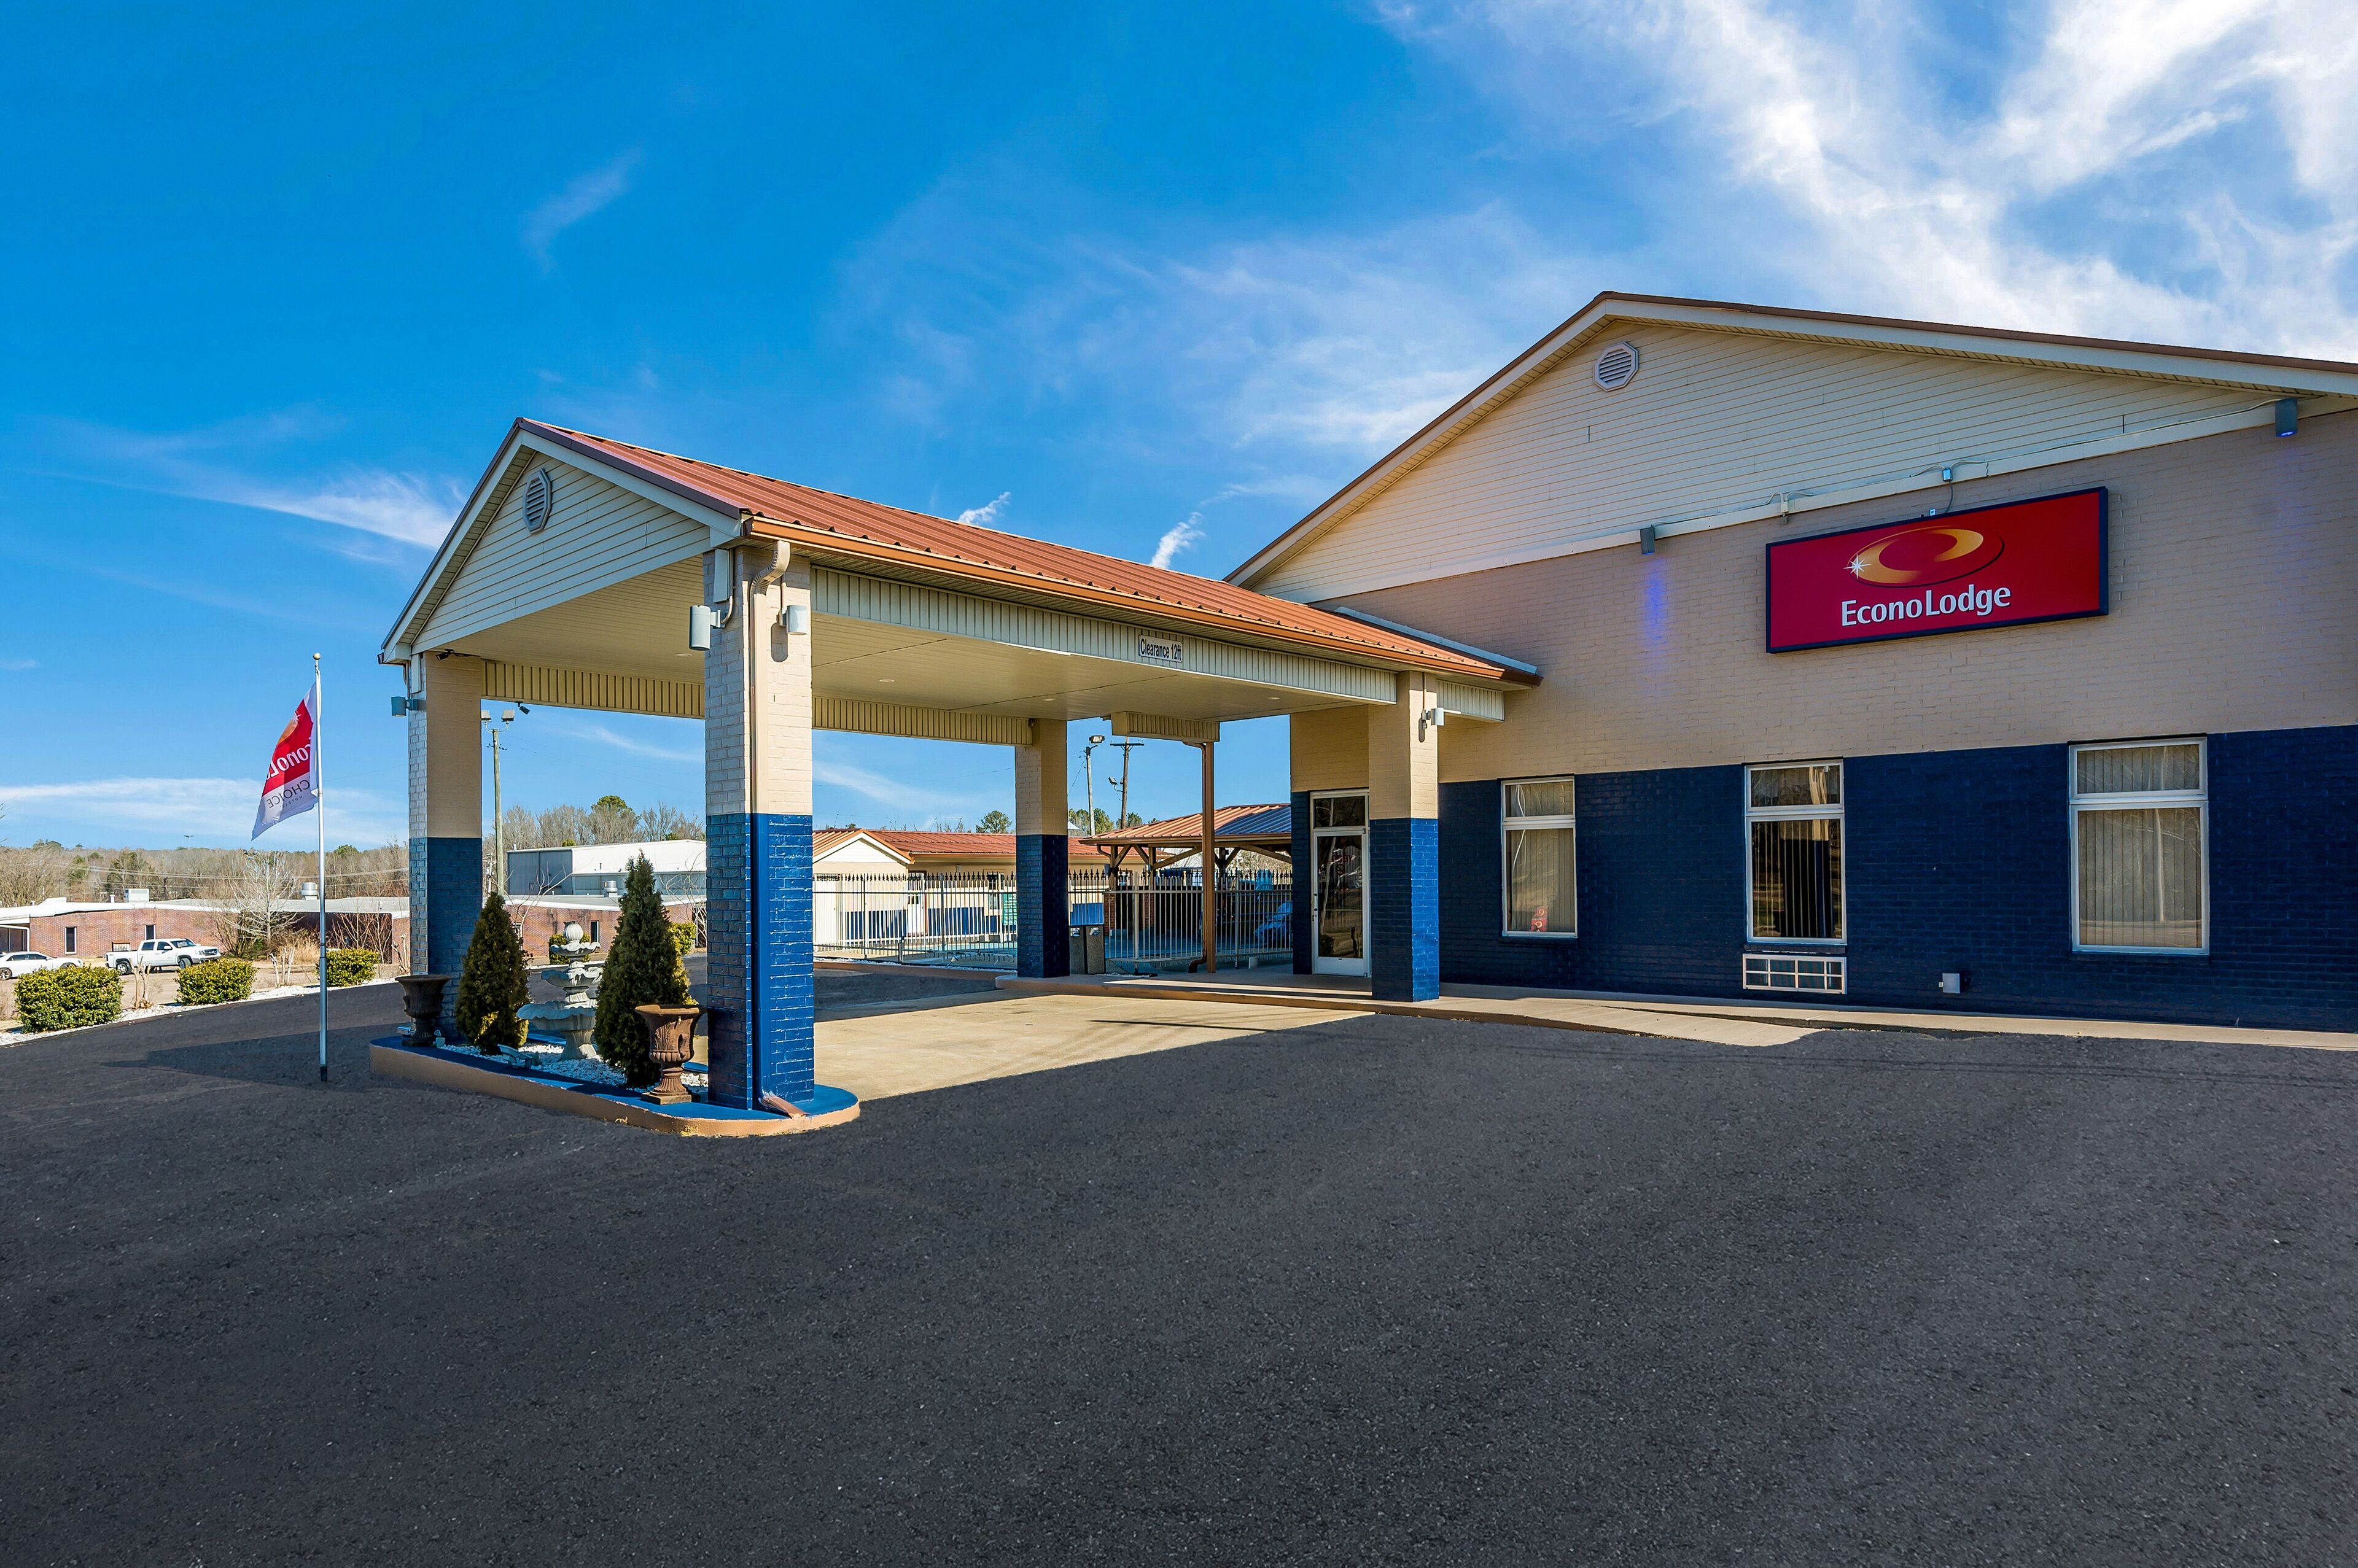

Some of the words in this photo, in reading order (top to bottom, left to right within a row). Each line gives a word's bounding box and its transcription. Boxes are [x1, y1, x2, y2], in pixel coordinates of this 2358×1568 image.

[1842, 584, 2011, 626] EconoLodge
[1140, 638, 1169, 658] Clearance
[1171, 644, 1181, 660] 12ft
